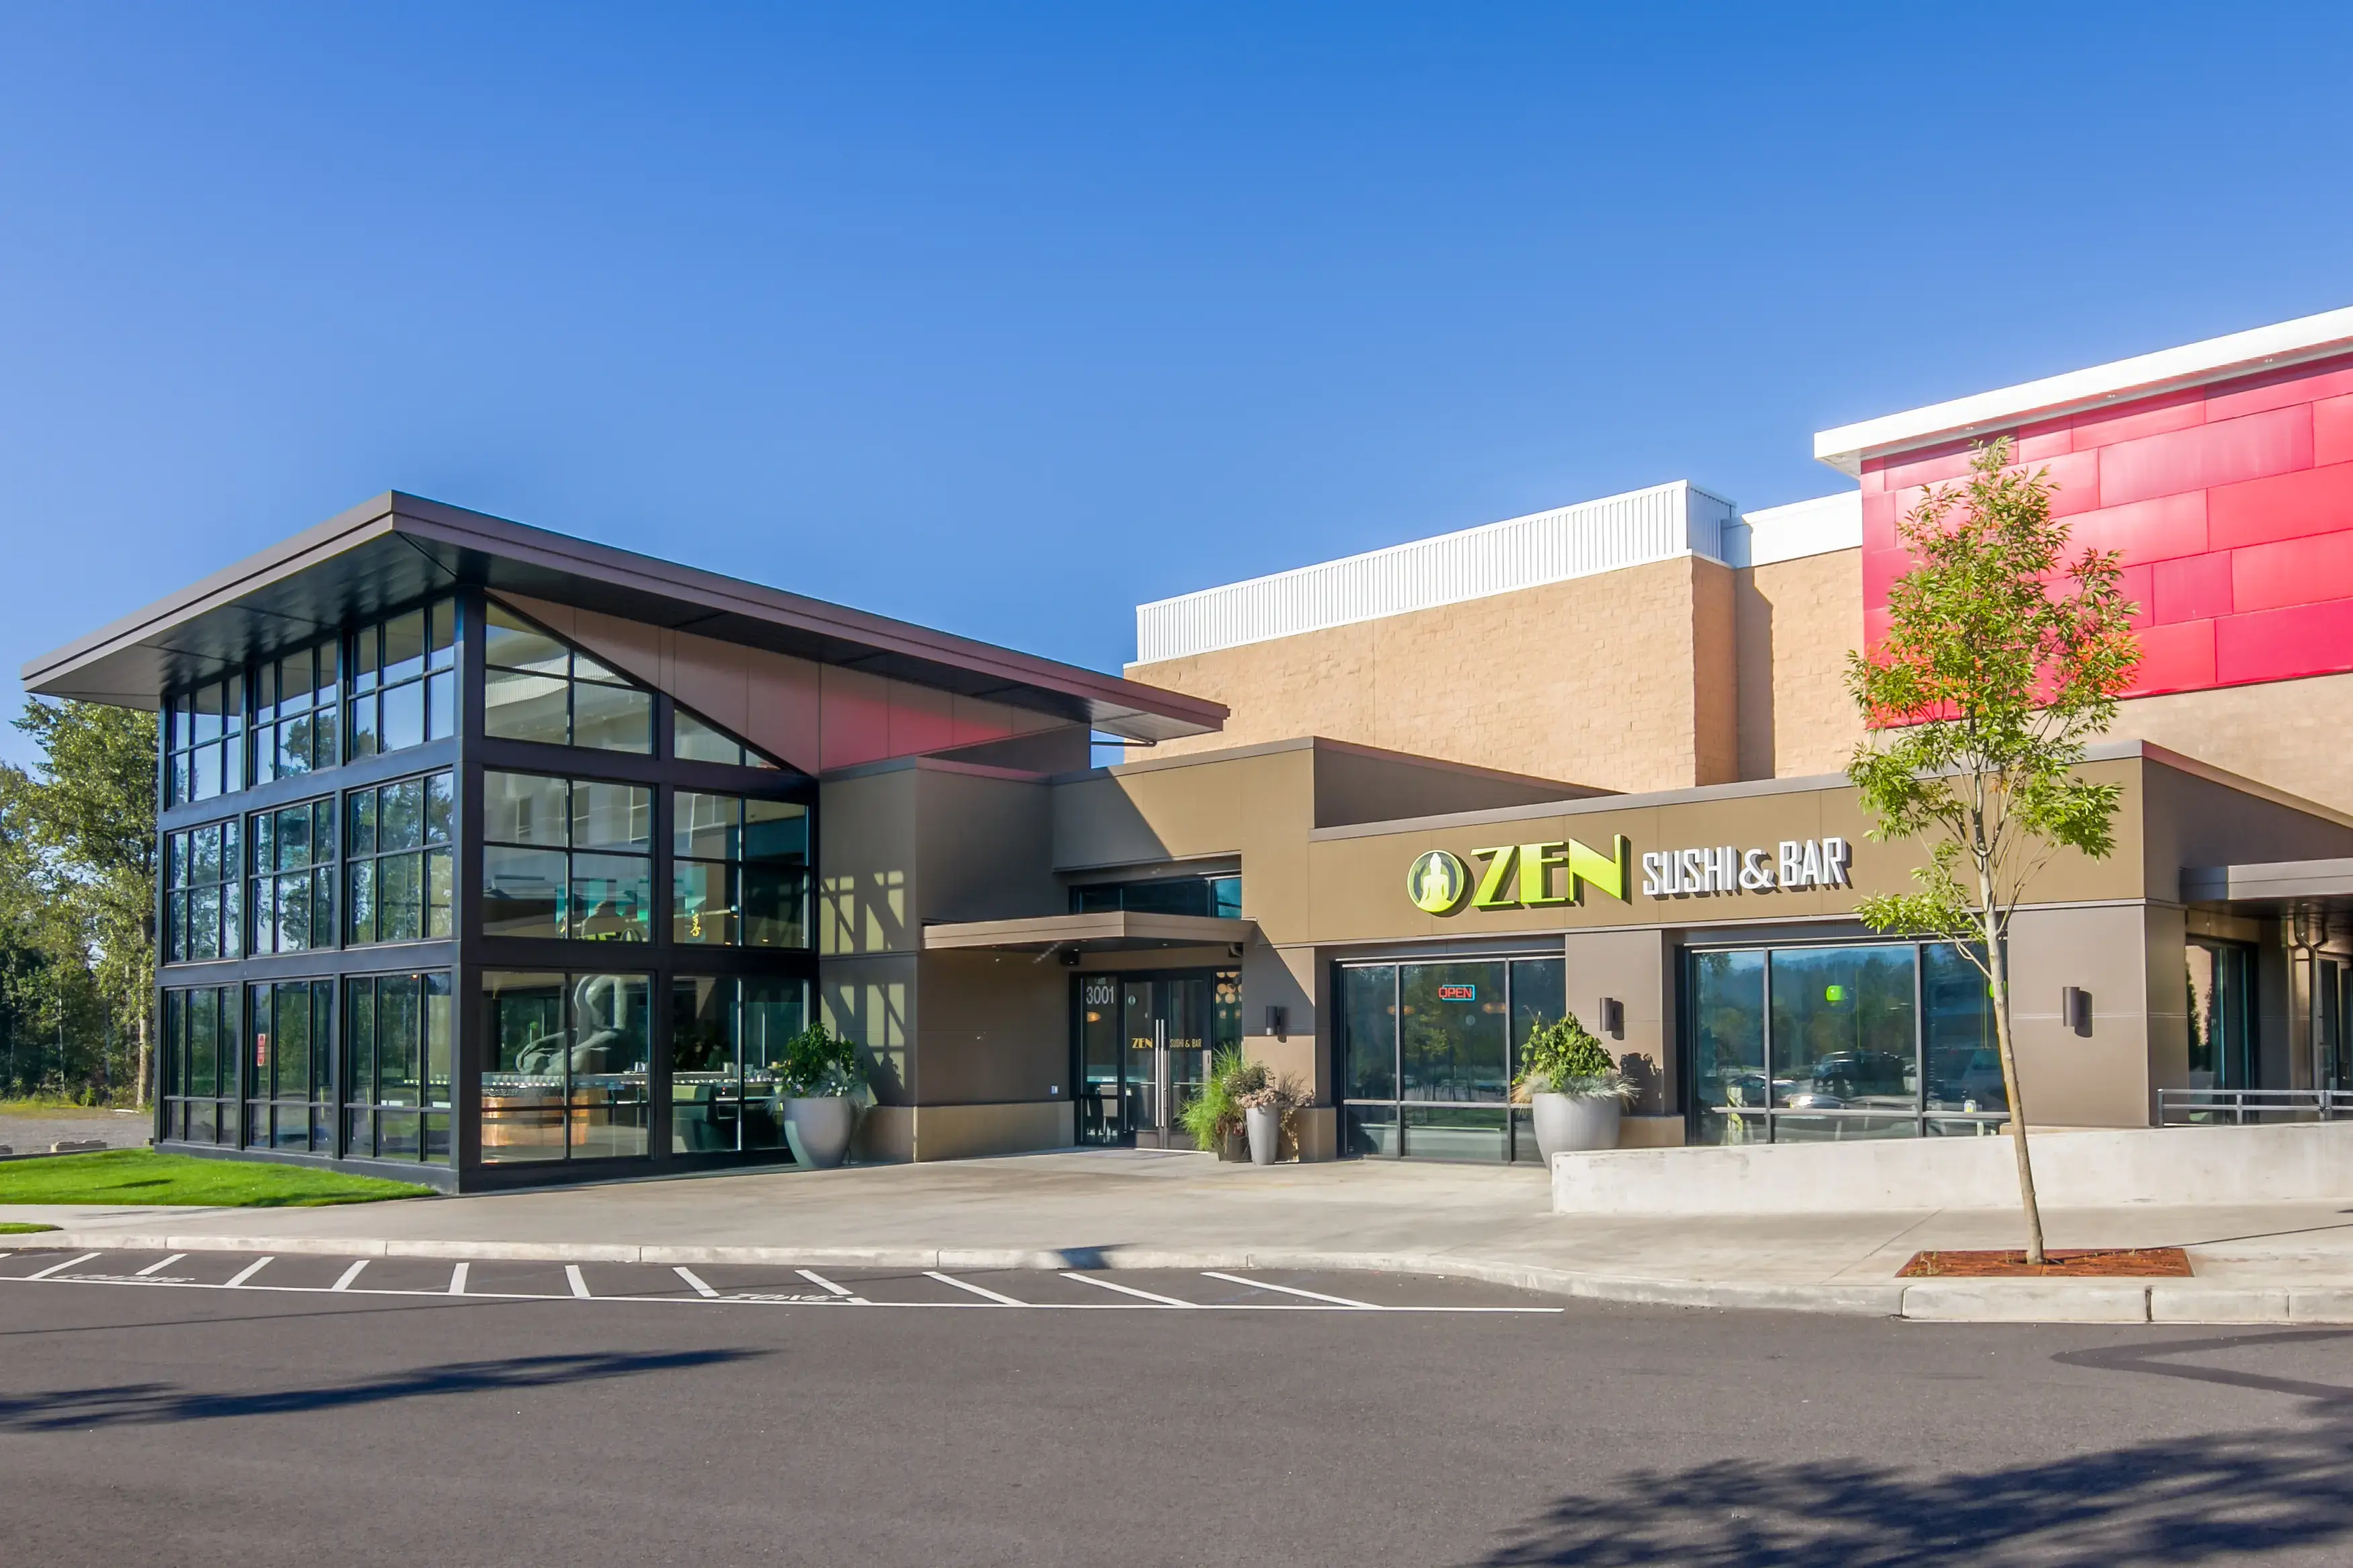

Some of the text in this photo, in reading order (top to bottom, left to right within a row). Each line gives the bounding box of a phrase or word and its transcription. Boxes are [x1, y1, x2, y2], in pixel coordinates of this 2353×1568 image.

[1470, 833, 1846, 907] ZEN SUSHI & BAR
[1086, 985, 1114, 1005] 3001
[1438, 987, 1472, 998] OPEN
[1132, 1037, 1202, 1049] ZEN SUSHI & BAR
